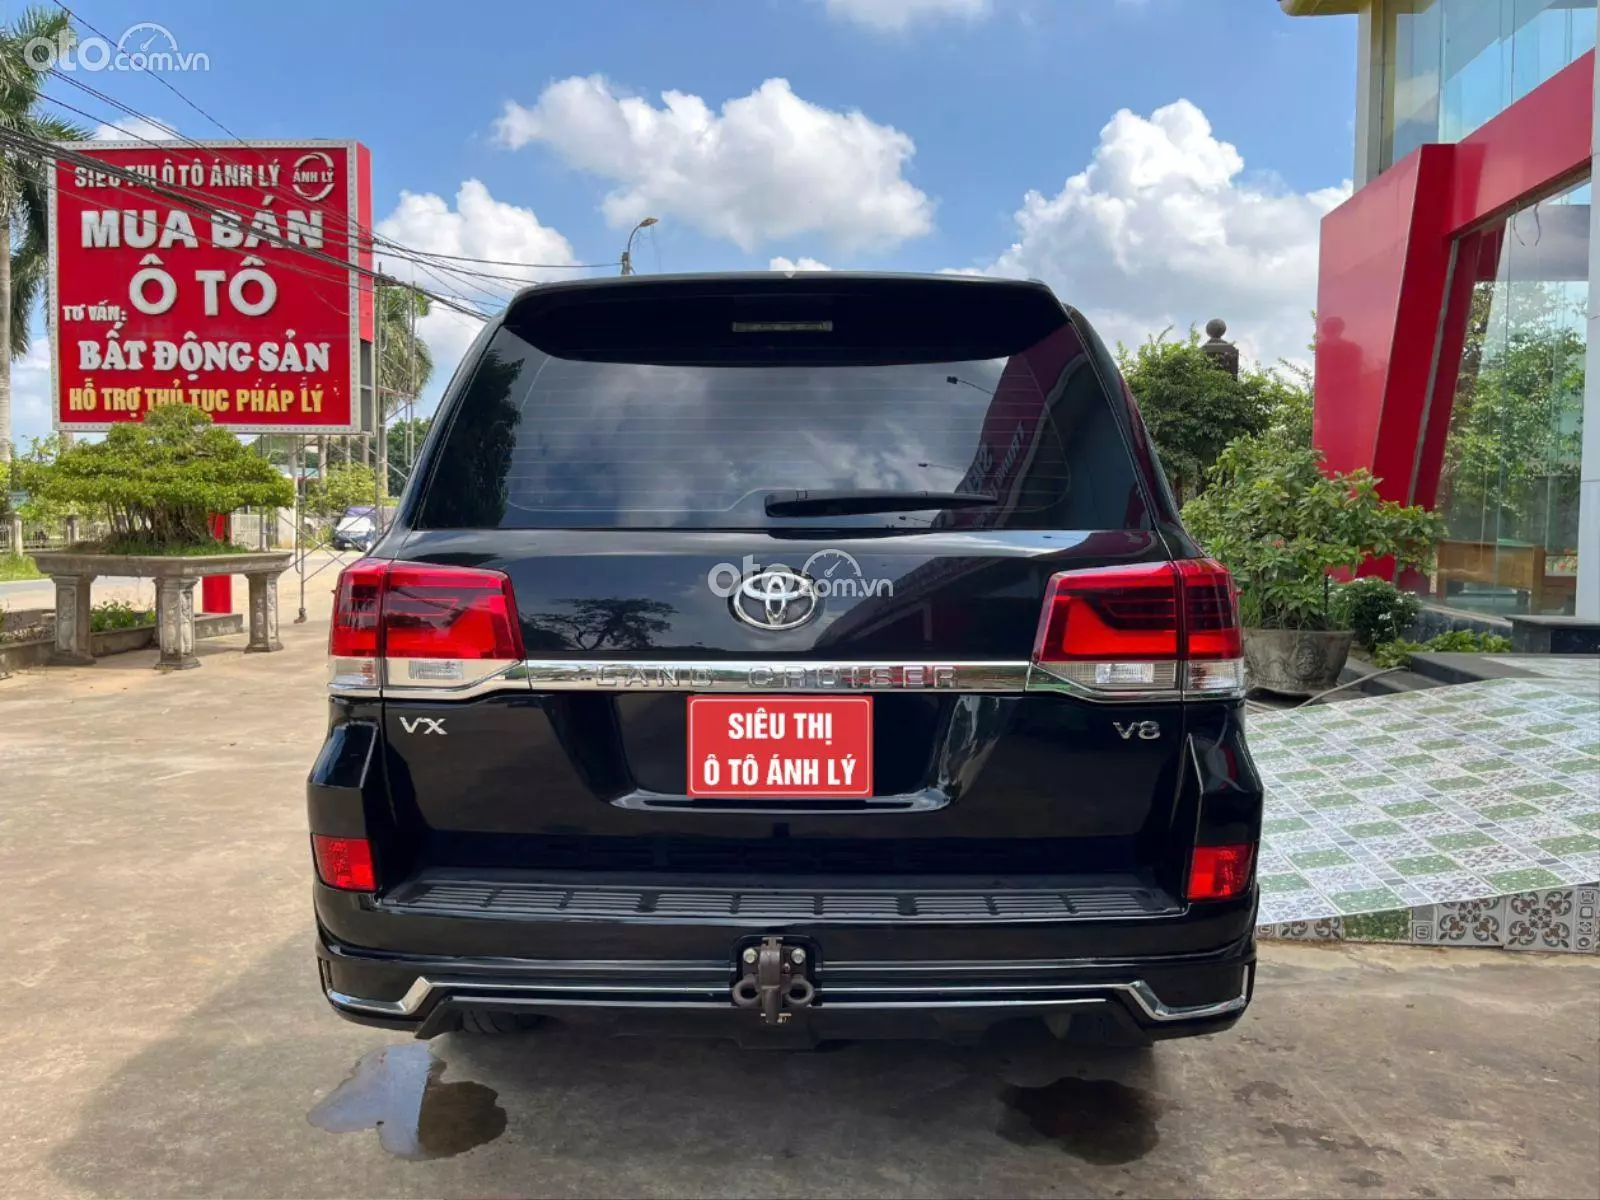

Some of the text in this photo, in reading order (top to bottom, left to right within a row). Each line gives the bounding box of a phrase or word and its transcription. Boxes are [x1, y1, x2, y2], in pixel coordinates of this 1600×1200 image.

[162, 158, 175, 187] Ô
[178, 158, 205, 187] TÔ
[209, 158, 253, 187] ÁNH
[258, 158, 281, 187] LÝ
[293, 168, 335, 183] ÁNH LÝ
[81, 195, 324, 249] MUA BÁN
[128, 253, 278, 317] Ô TÔ
[77, 321, 331, 381] BẤT ĐỘNG SẢN
[69, 377, 97, 412] HỖ
[101, 386, 142, 418] TRỢ
[236, 382, 295, 413] PHÁP
[301, 382, 324, 413] LÝ
[596, 664, 959, 689] LAND CRUISER
[399, 716, 448, 735] VX
[728, 707, 833, 745] SIÊU THỊ
[1112, 720, 1160, 740] V8
[703, 753, 857, 786] Ô TÔ ÁNH LÝ
